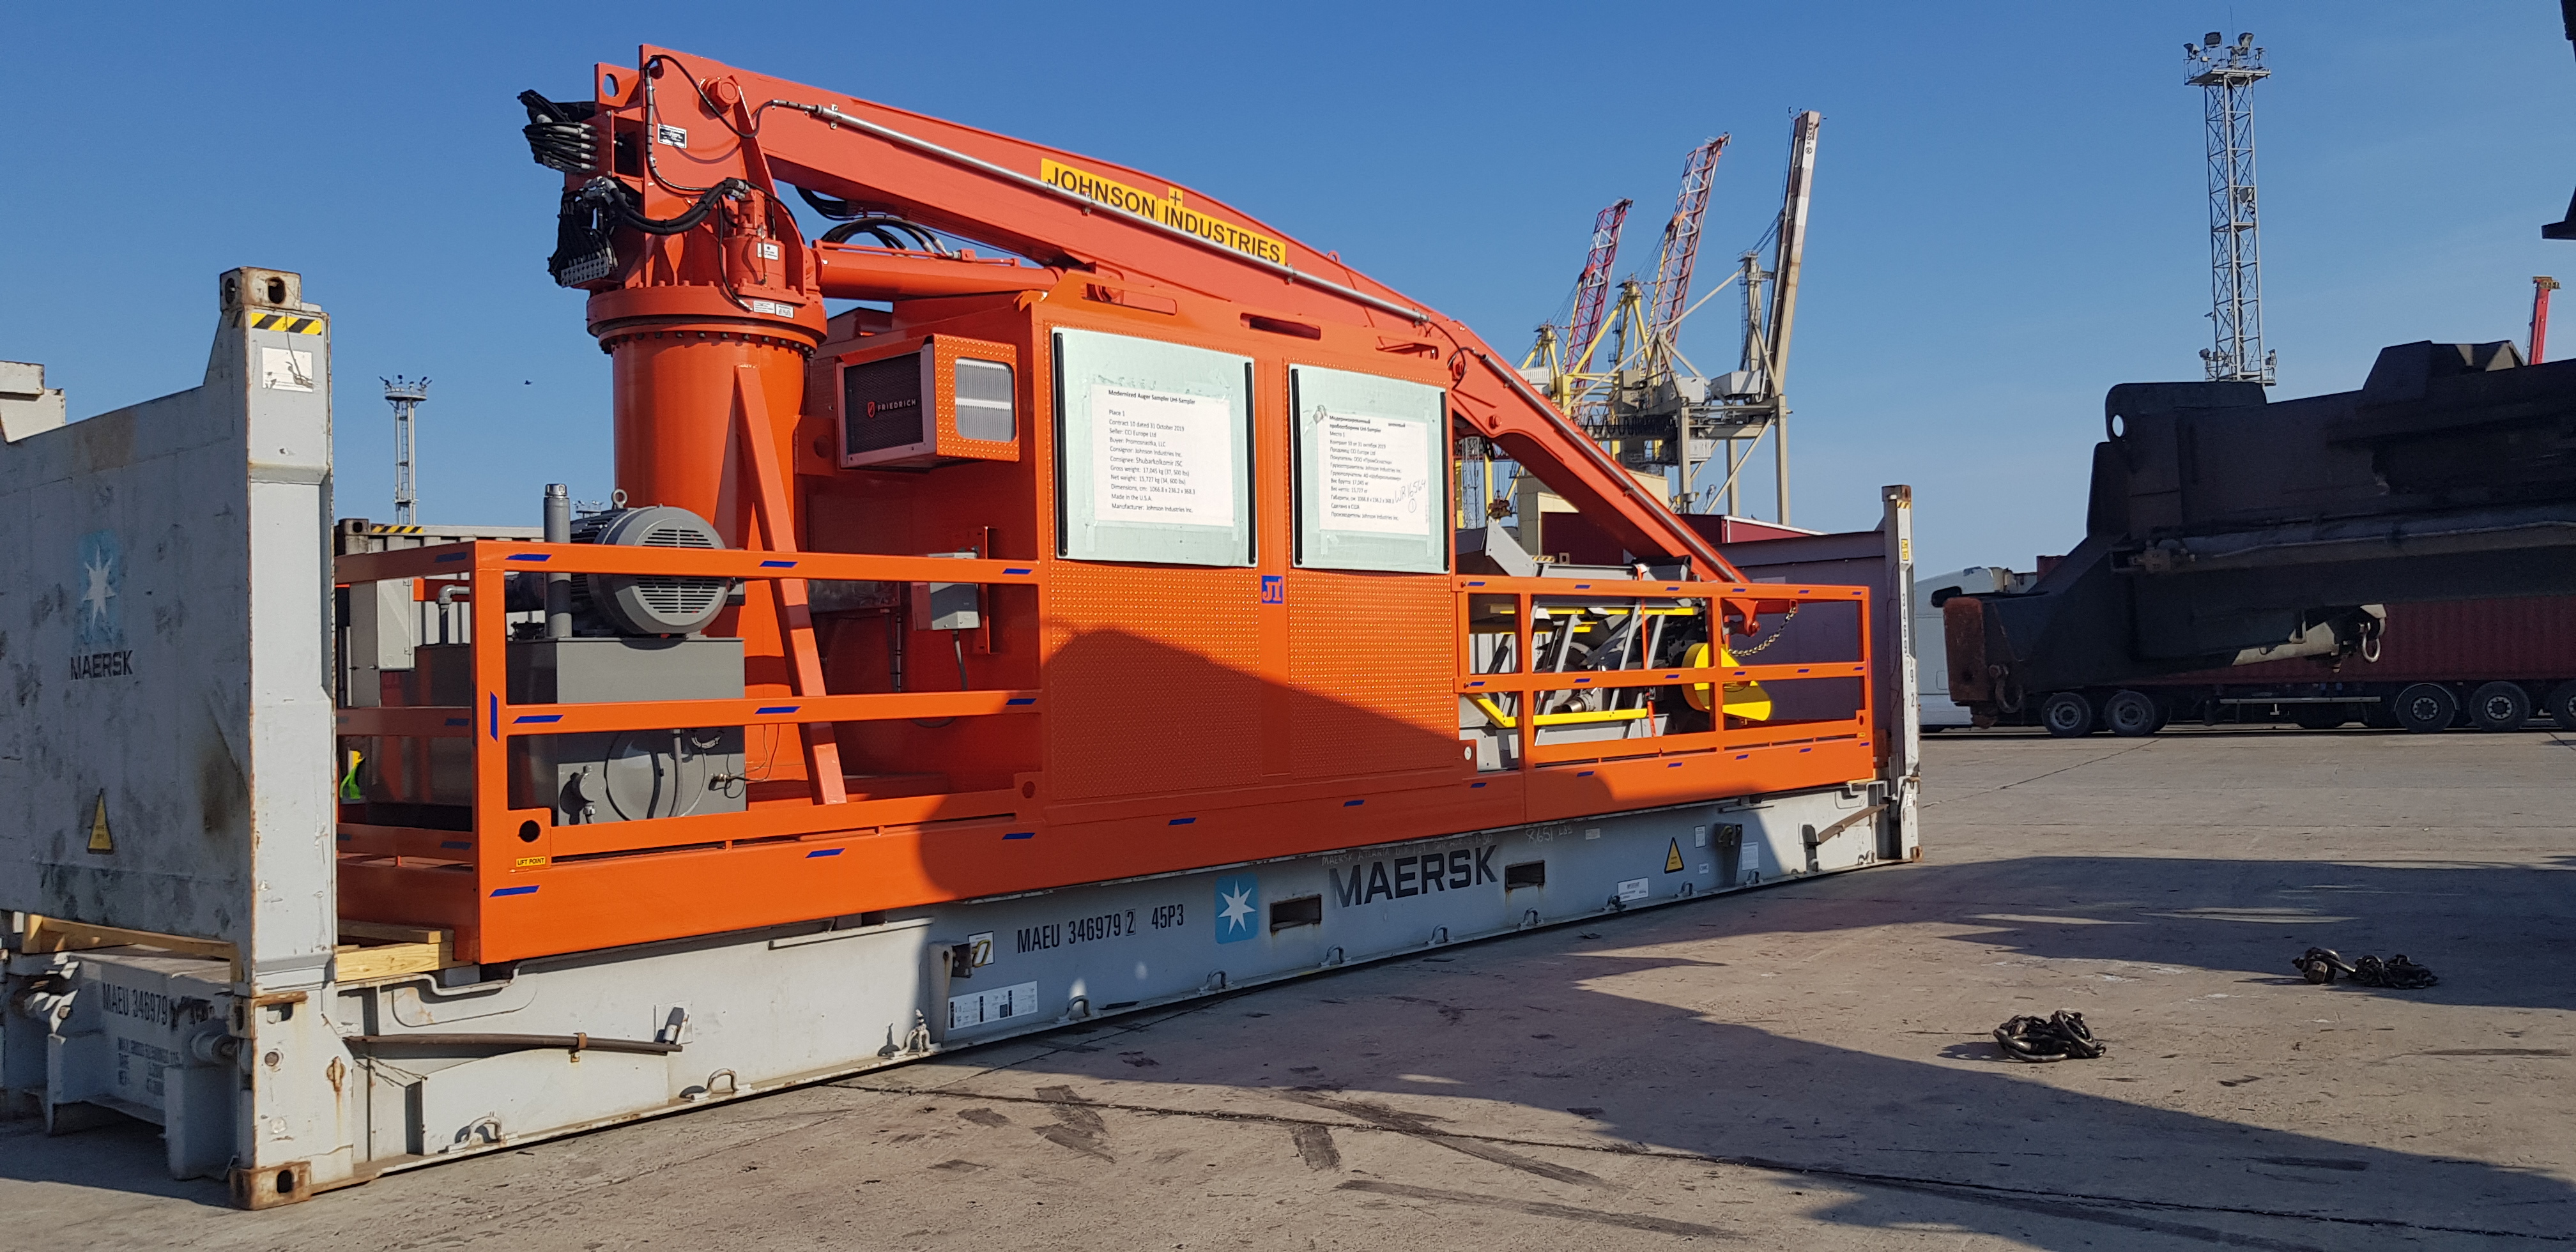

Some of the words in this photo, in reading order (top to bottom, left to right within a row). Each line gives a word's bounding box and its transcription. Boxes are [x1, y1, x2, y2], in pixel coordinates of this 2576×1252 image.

[1047, 167, 1155, 220] JOHNSON
[1164, 205, 1281, 264] INDUSTRIES
[877, 399, 916, 412] FRIEDRICH
[1108, 390, 1137, 398] Modernized
[1328, 844, 1498, 909] MAERSK
[1017, 924, 1061, 954] MAEU
[1068, 913, 1121, 945] 346979
[1126, 911, 1134, 934] 2
[1151, 904, 1184, 929] 45P3
[103, 982, 129, 1016] MAEU
[132, 989, 169, 1026] 346979
